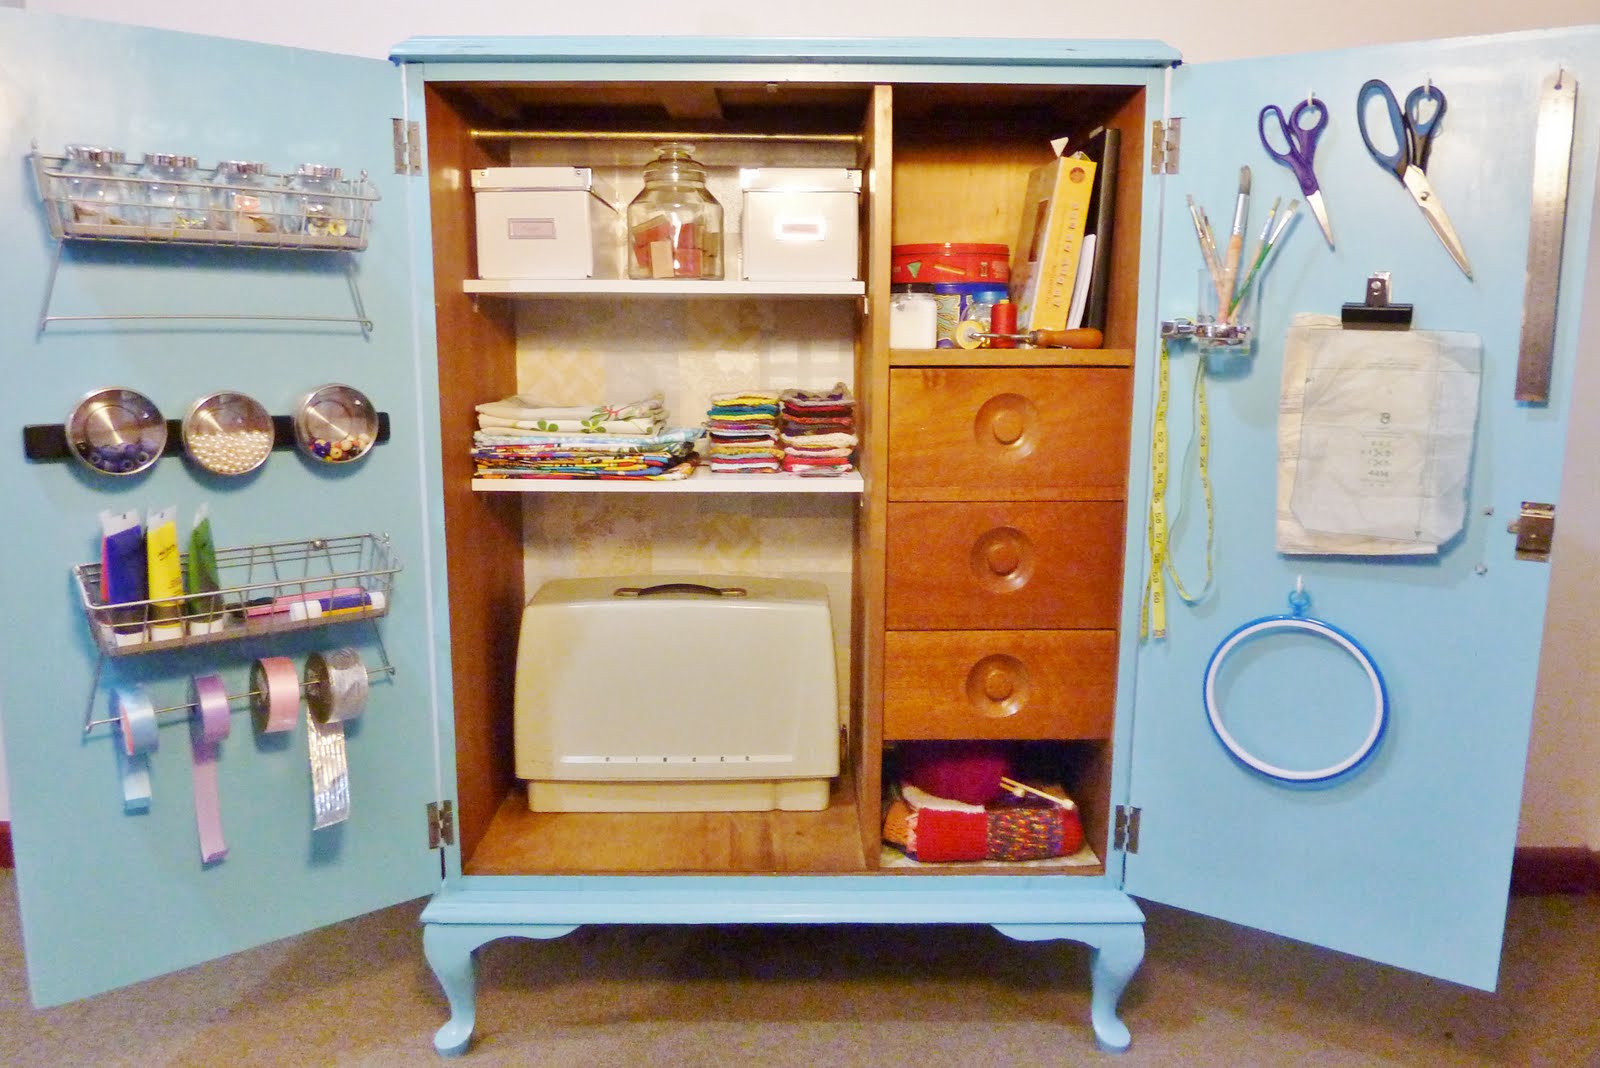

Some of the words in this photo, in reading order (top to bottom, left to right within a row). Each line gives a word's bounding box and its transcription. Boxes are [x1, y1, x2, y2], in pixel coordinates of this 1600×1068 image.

[1380, 411, 1391, 425] 8
[1157, 431, 1164, 444] 52
[1157, 451, 1164, 464] 53
[1157, 472, 1164, 485] 54
[1155, 512, 1162, 525] 56
[1156, 532, 1162, 545] 57
[1152, 571, 1159, 584] 59
[1153, 591, 1160, 604] 60
